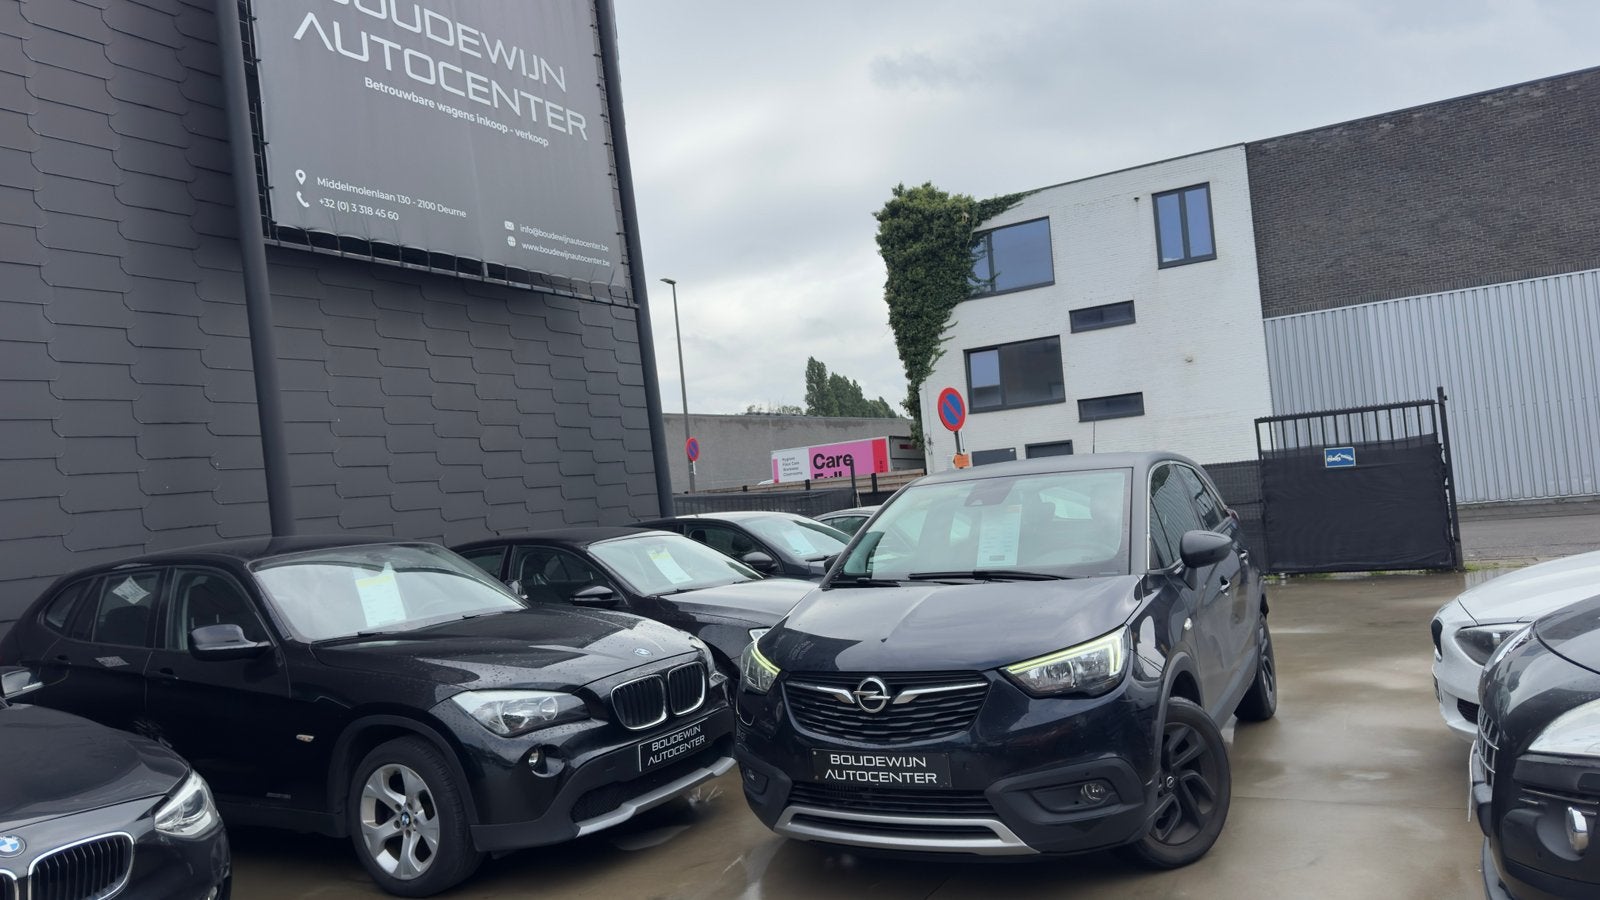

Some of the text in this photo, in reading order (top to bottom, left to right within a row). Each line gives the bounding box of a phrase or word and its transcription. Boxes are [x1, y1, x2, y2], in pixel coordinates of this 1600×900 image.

[293, 12, 588, 141] AUTOCENTER
[364, 76, 435, 108] Betrouwbare
[436, 102, 475, 122] wagens
[476, 113, 508, 134] inkoop
[514, 127, 549, 147] verkoop
[317, 177, 396, 202] Middelmolenlaan
[396, 194, 411, 205] 130
[417, 199, 436, 211] 2100
[437, 203, 467, 218] Deurne
[319, 197, 399, 221] +32 (0) 3 318 45 60
[520, 224, 609, 252] info@boudewijnautocenter.be
[521, 242, 610, 267] www.boudewijnautocenter.be
[813, 453, 854, 470] Care
[647, 734, 706, 766] AUTOCENTER
[651, 725, 701, 752] BOUDEWIJN
[830, 754, 927, 768] BOUDEWIJN
[825, 769, 937, 784] AUTOCENTER
